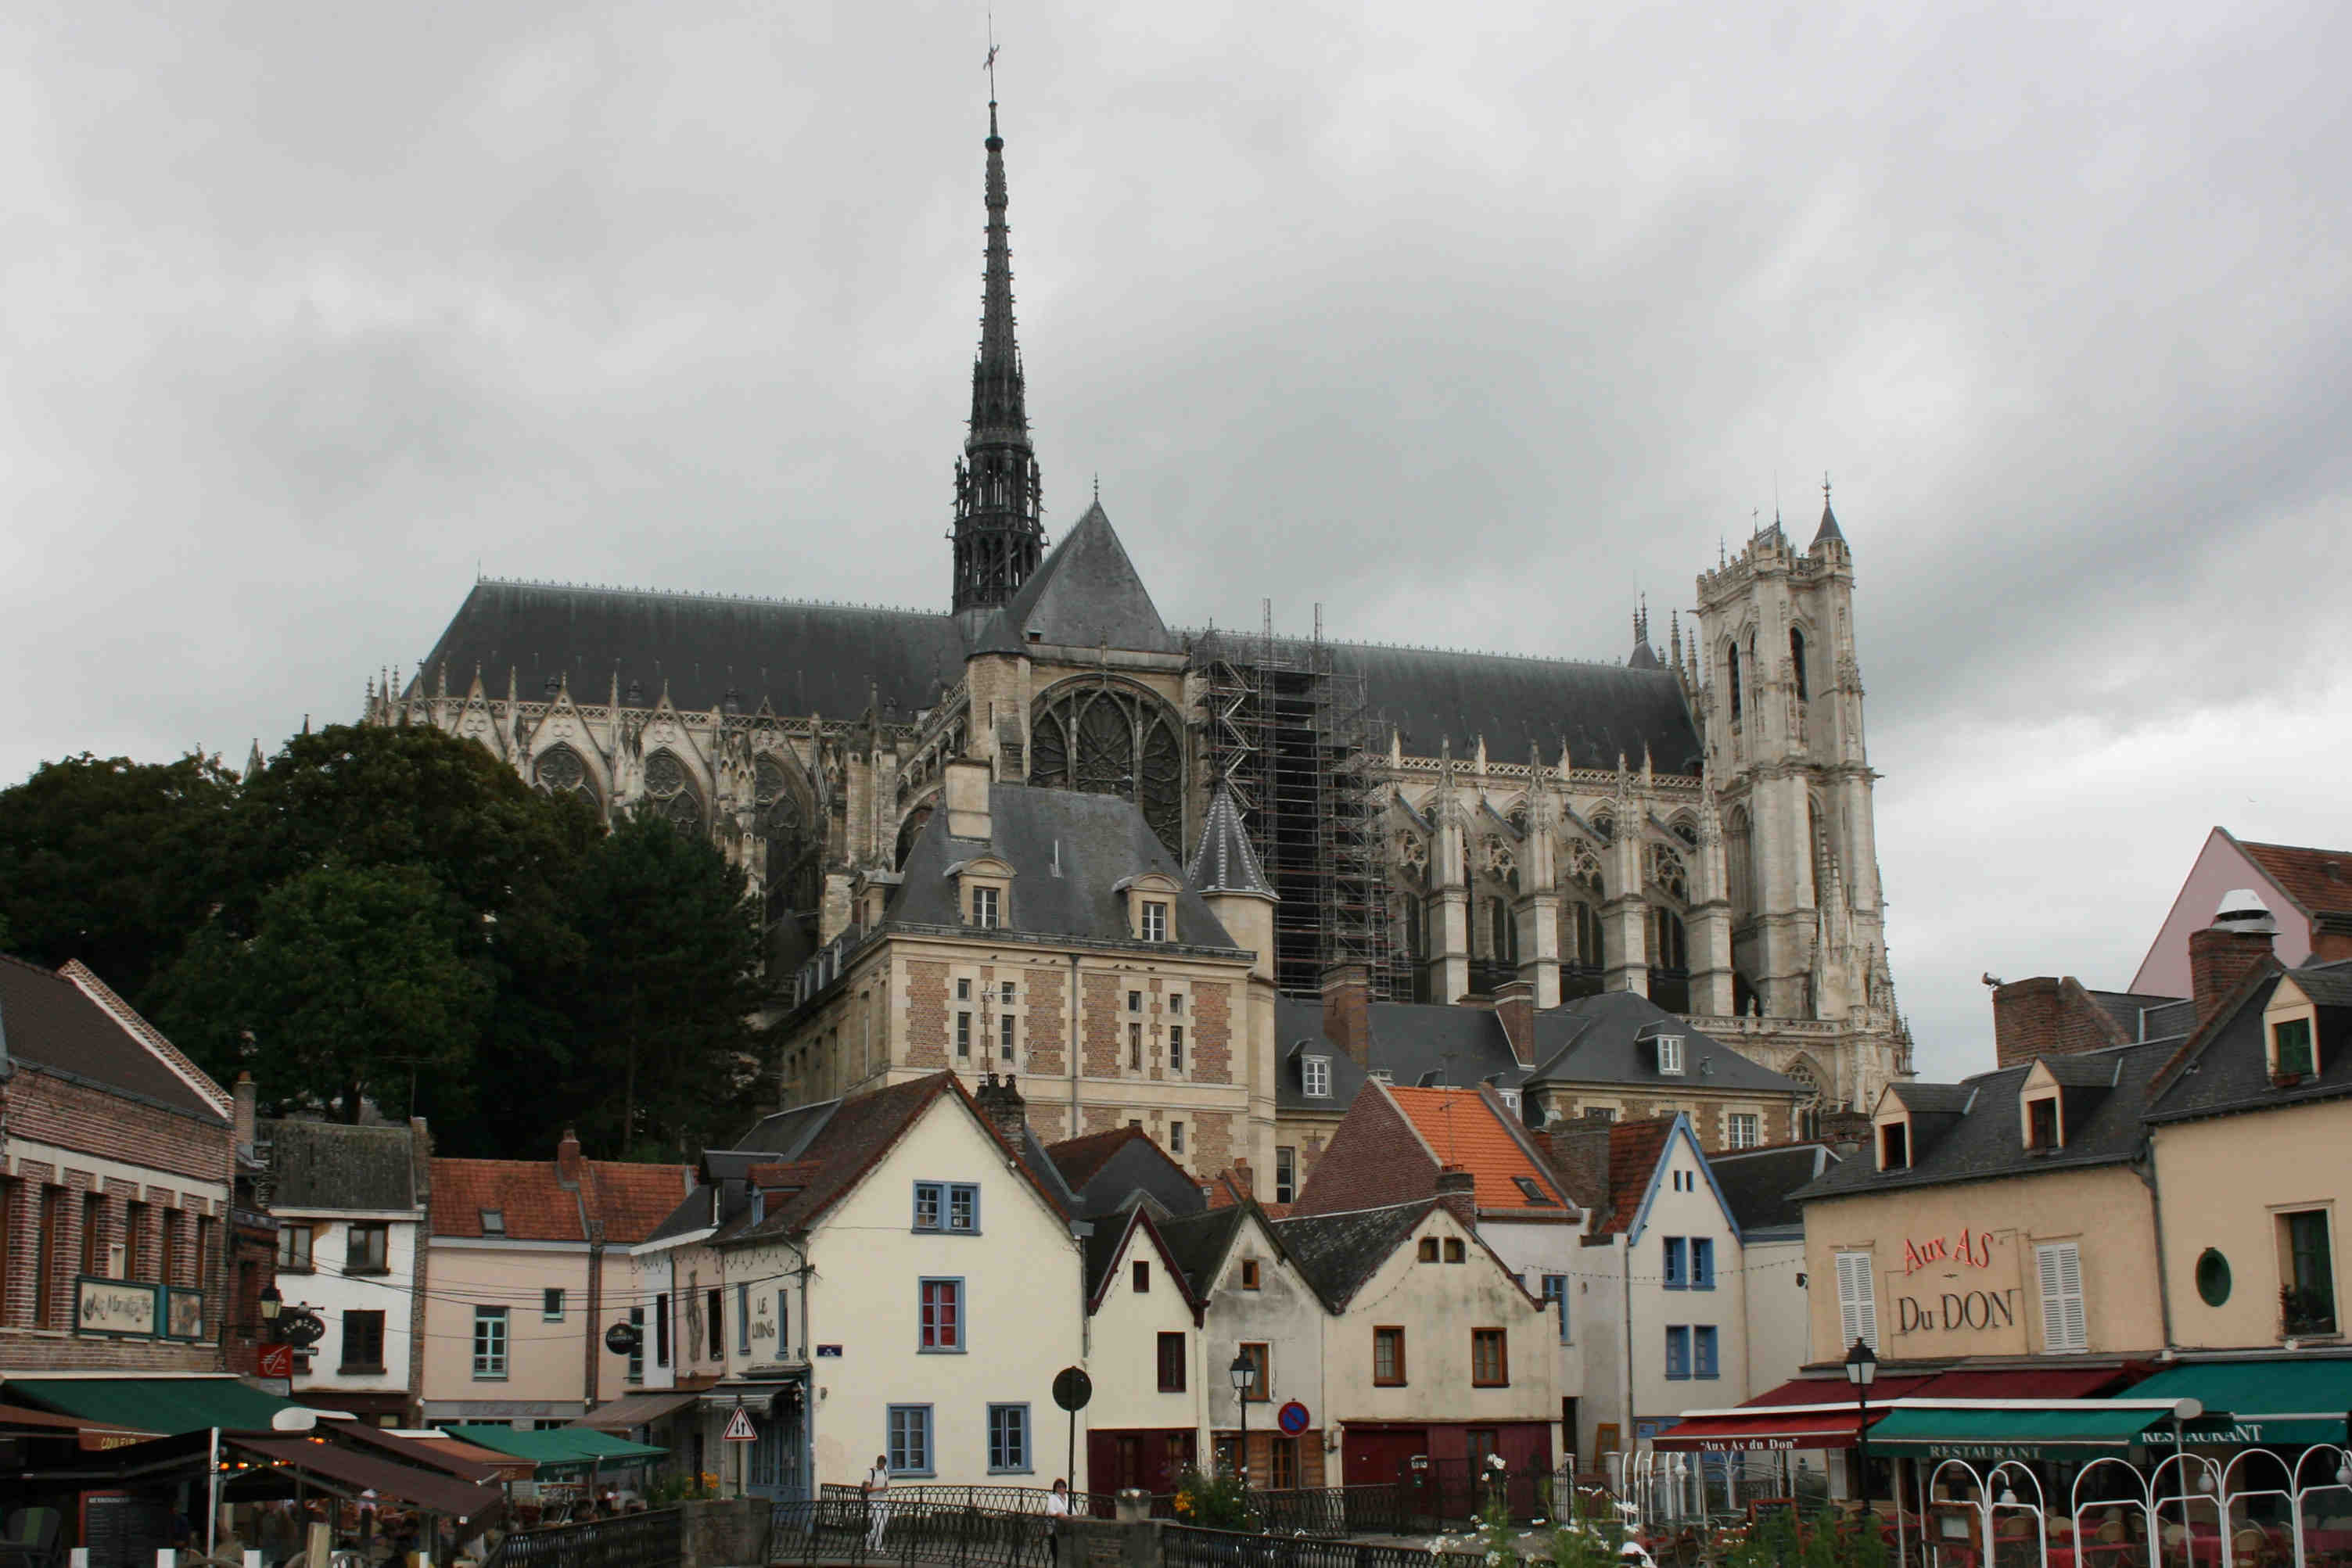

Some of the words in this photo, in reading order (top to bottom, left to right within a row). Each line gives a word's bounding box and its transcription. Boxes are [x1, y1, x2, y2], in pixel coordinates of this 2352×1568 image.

[1905, 1237, 1948, 1276] Aux
[1952, 1226, 1994, 1268] AS
[1898, 1297, 1934, 1332] Du
[1940, 1290, 2013, 1331] DON
[1732, 1440, 1745, 1451] As
[1749, 1439, 1764, 1450] du
[1930, 1445, 2041, 1459] RESTAURANT
